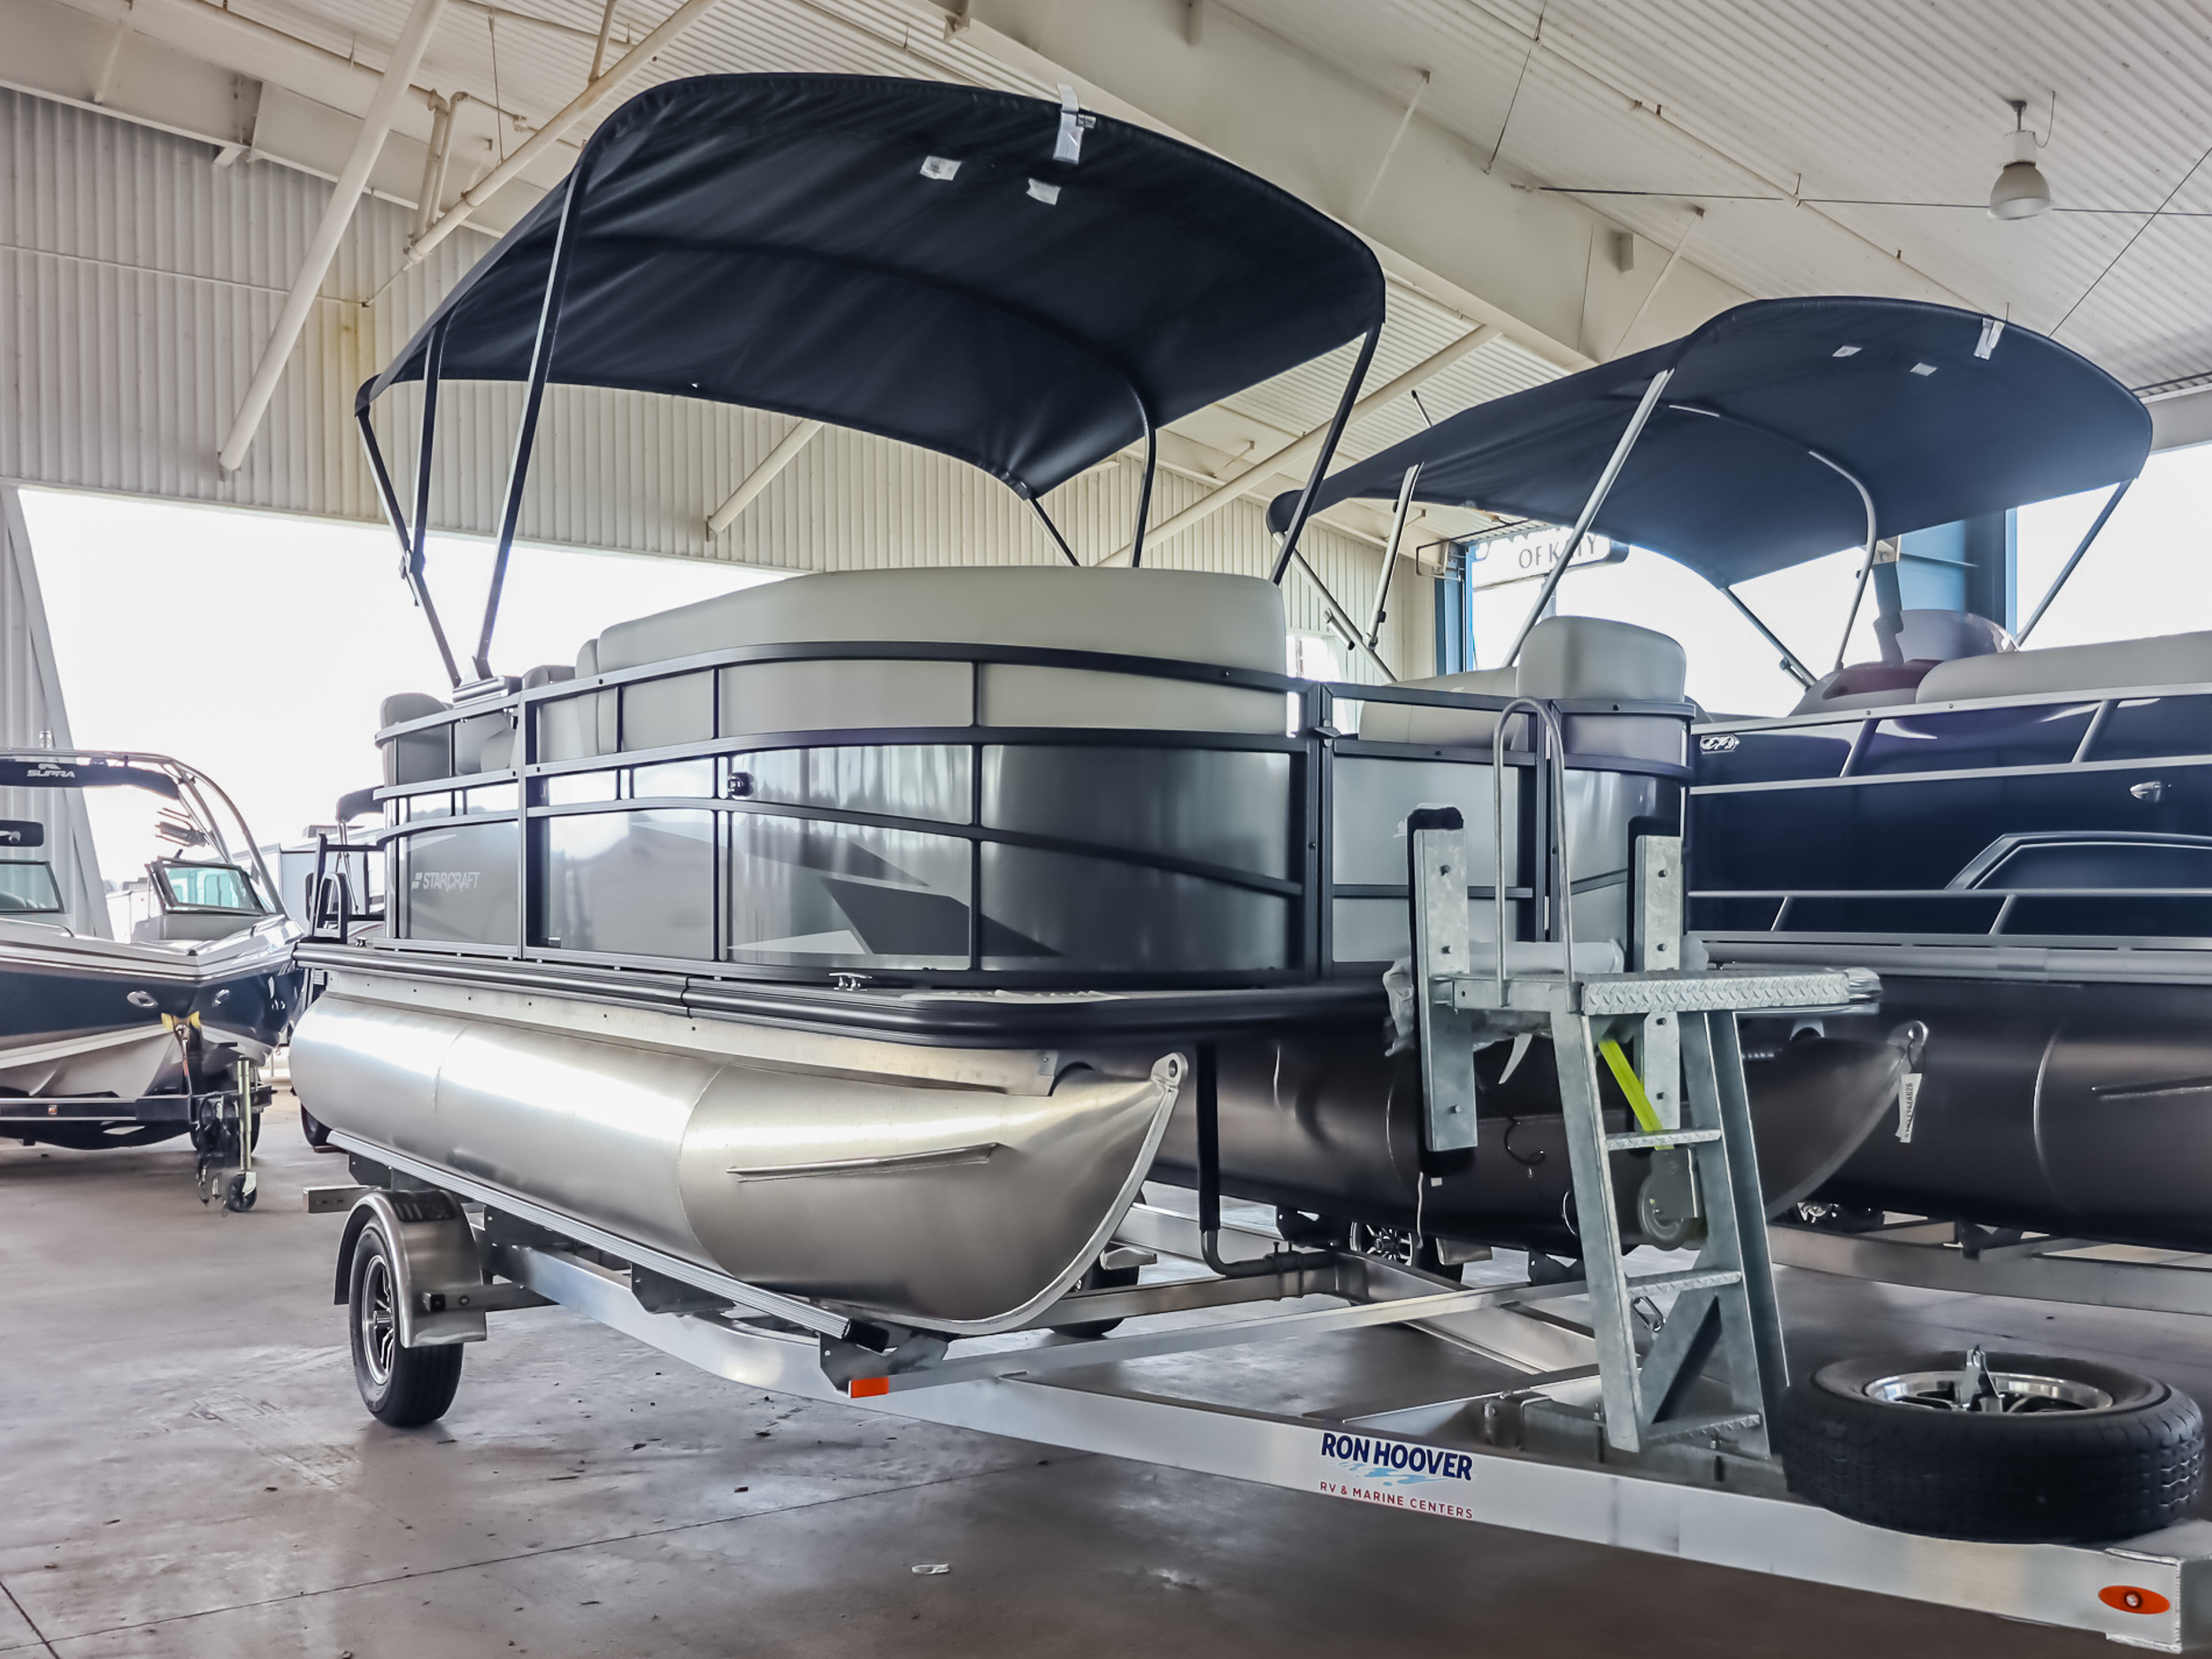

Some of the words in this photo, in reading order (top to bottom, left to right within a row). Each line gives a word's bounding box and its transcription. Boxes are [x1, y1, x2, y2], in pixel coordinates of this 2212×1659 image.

[1518, 545, 1542, 568] OF
[27, 769, 75, 778] SUPRA
[423, 872, 480, 892] STARCRAFT
[1321, 1432, 1371, 1463] RON
[1373, 1440, 1473, 1480] HOOVER
[1320, 1481, 1336, 1493] RV
[1340, 1485, 1348, 1495] &
[1353, 1487, 1404, 1505] MARINE
[1409, 1498, 1473, 1519] CENTERS
